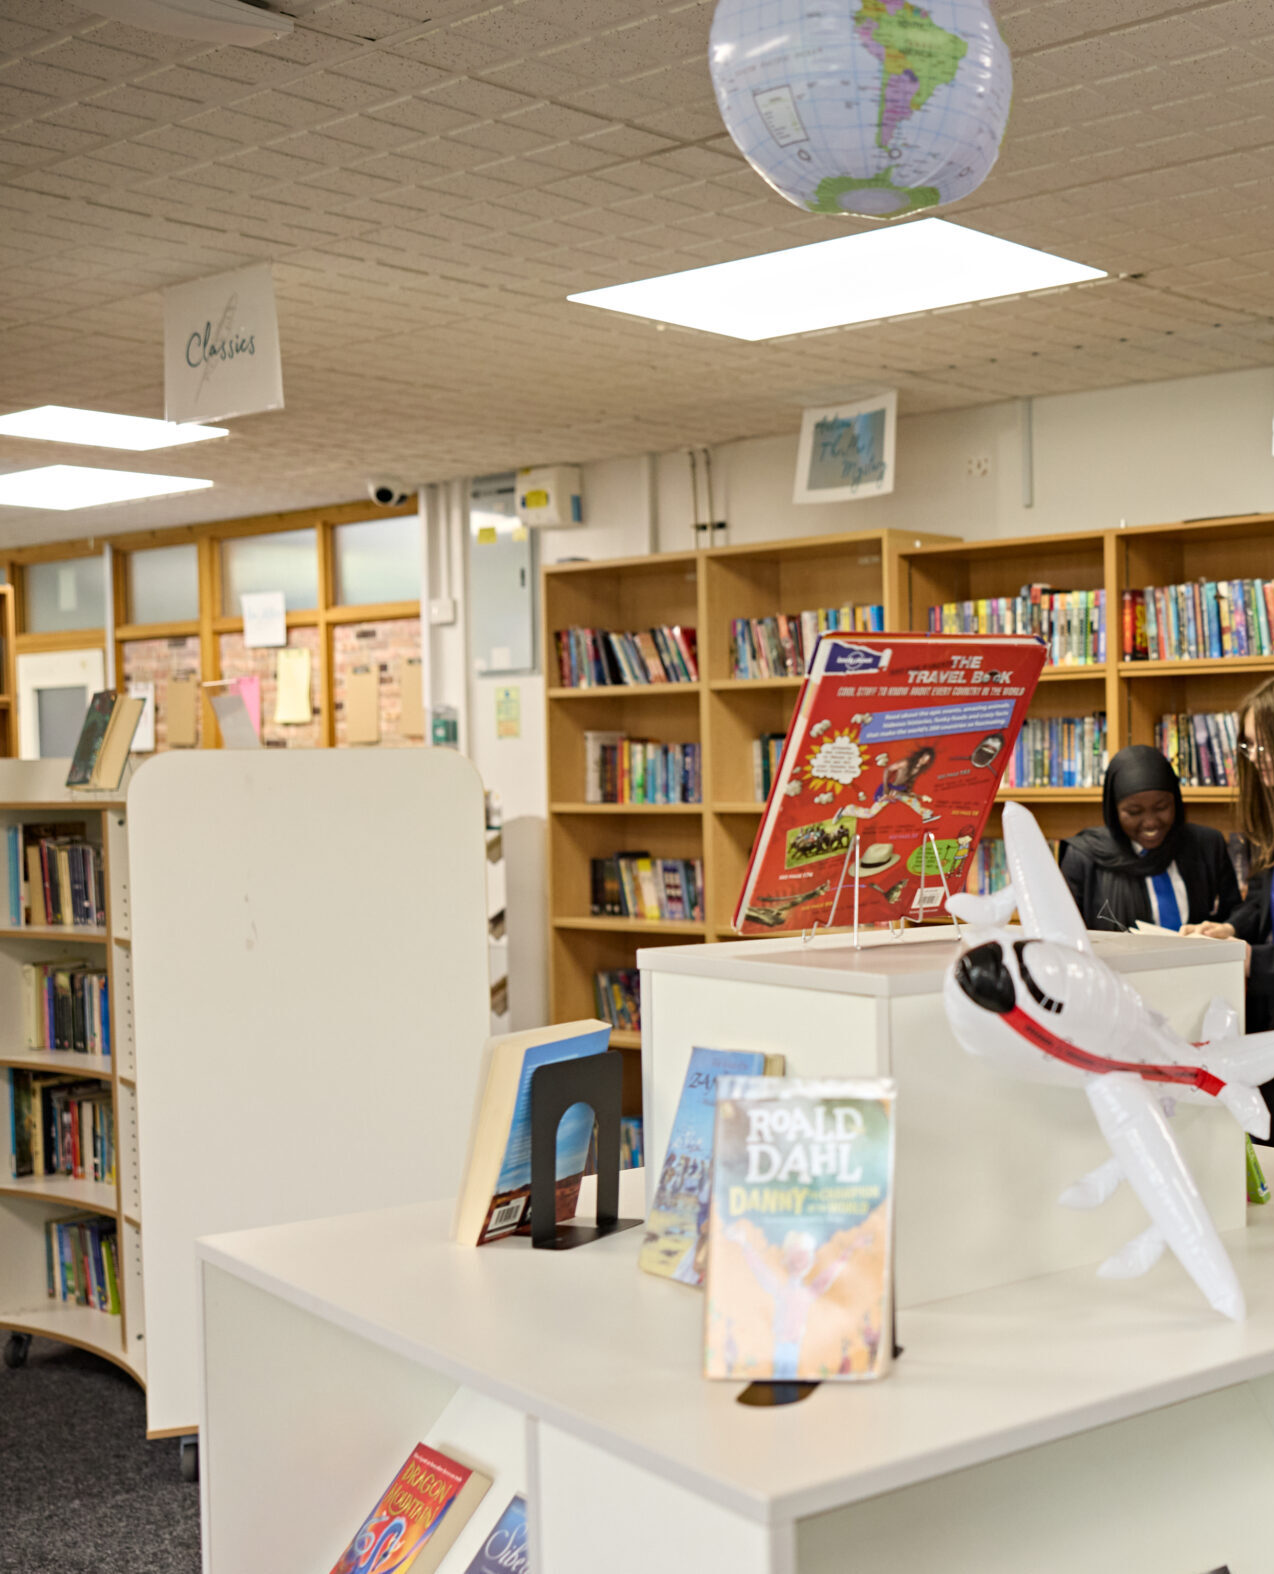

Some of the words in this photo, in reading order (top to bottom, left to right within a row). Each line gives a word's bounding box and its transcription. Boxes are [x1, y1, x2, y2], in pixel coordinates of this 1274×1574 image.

[186, 321, 255, 368] Classics
[907, 671, 967, 684] TRAVEL
[951, 655, 983, 669] THE
[745, 1106, 865, 1143] ROALD
[745, 1143, 863, 1184] DAHL
[728, 1185, 809, 1217] DANNY
[402, 1461, 452, 1505] DRAGON
[385, 1483, 444, 1528] MOUNTAIN
